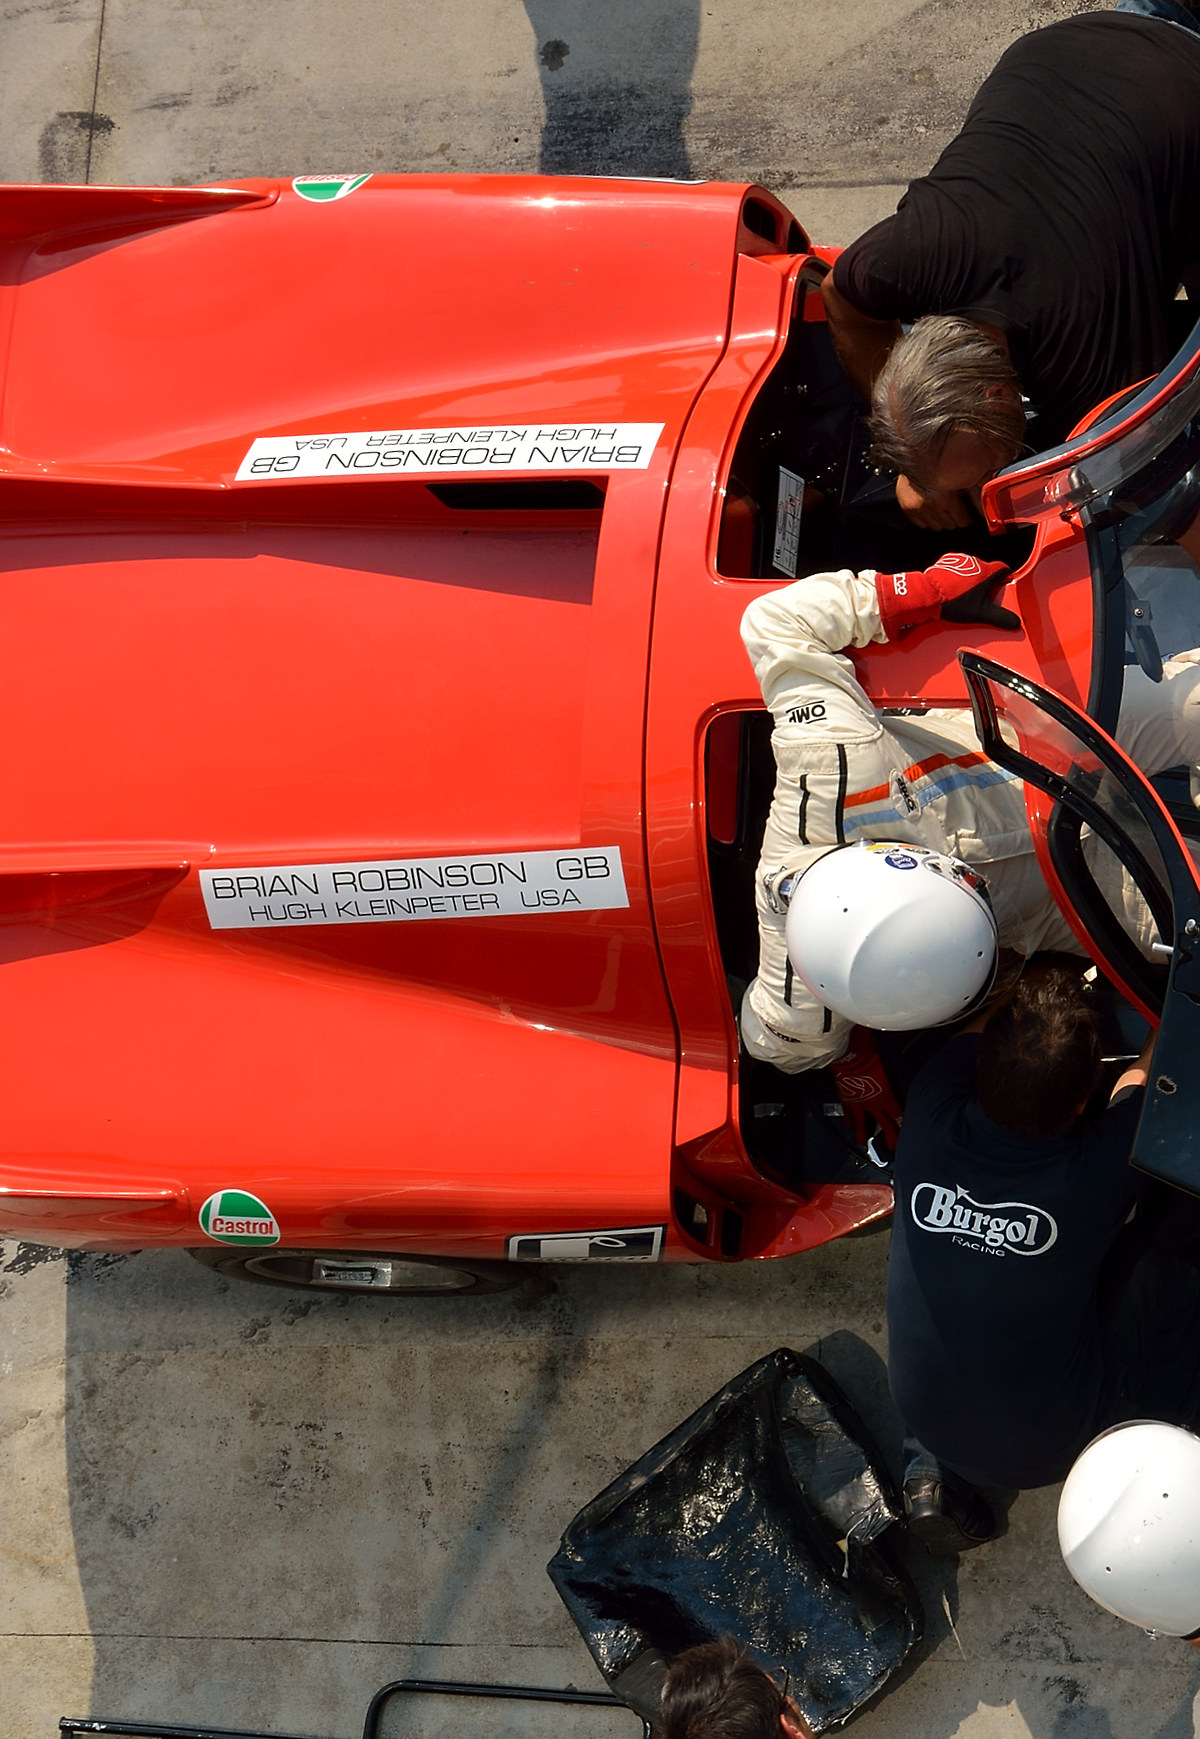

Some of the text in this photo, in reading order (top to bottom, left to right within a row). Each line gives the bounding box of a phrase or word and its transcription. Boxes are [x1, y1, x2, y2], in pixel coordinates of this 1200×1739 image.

[295, 428, 617, 450] HUGH KLEINPETER USA
[250, 445, 642, 473] BRIAN ROBINSON GB
[212, 855, 610, 899] BRIAN ROBINSON GB
[249, 888, 581, 921] HUGH KLEINPETER USA
[212, 1217, 273, 1235] Castrol
[924, 1187, 1039, 1247] Burgol
